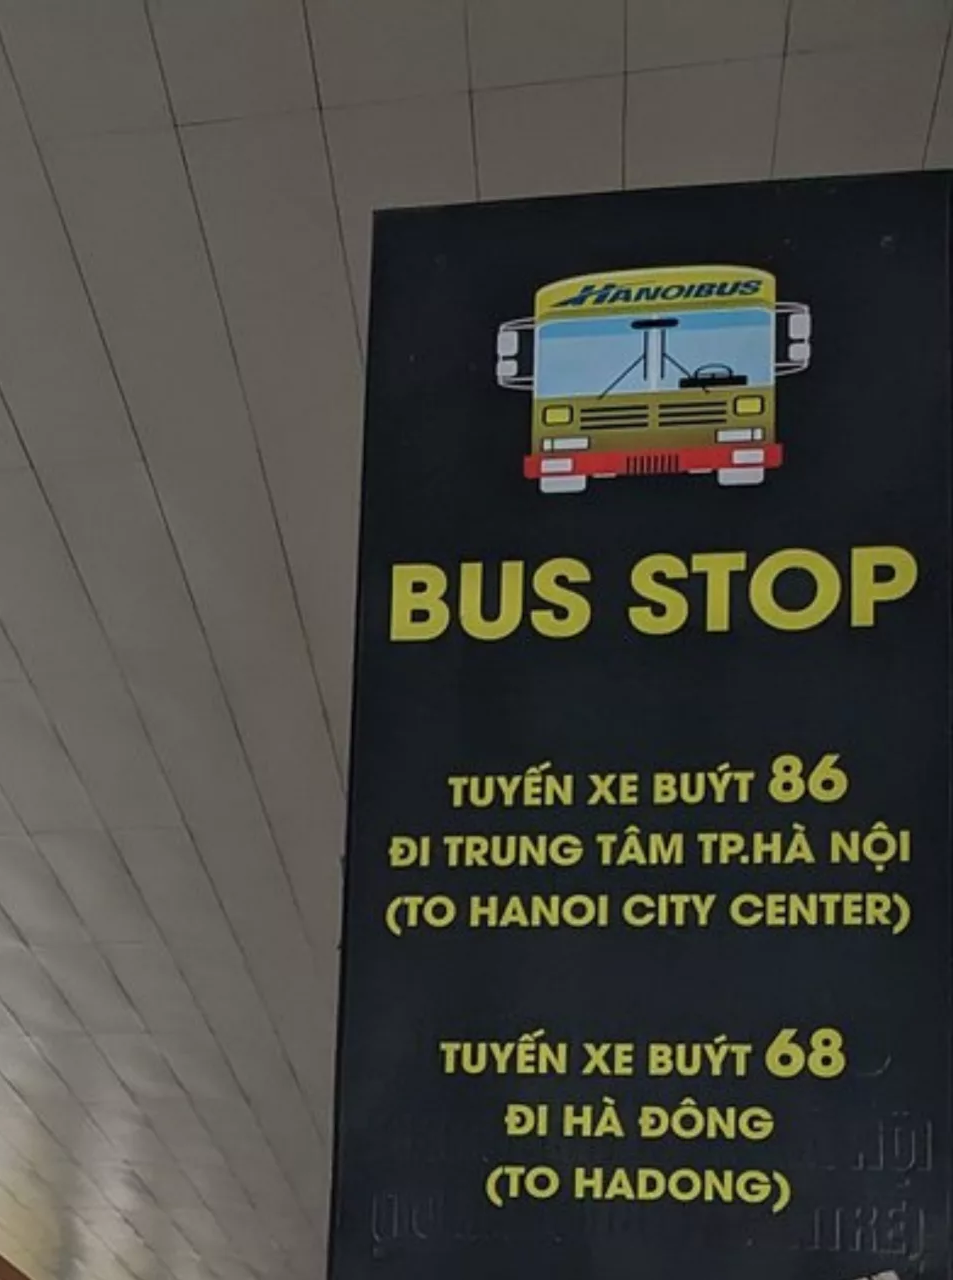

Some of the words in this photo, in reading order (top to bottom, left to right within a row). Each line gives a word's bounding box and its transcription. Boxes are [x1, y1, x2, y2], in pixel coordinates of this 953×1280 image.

[551, 279, 763, 308] HANOIBUS
[389, 556, 593, 642] BUS
[627, 545, 919, 636] STOP
[448, 761, 575, 807] TUYẾN
[588, 772, 639, 806] XE
[652, 762, 754, 804] BUÝT
[767, 753, 849, 804] 86
[388, 835, 431, 868] ĐI
[444, 833, 584, 868] TRUNG
[595, 823, 684, 865] TÂM
[829, 820, 911, 872] NỘI
[384, 894, 456, 936] (TO
[469, 894, 610, 928] HANOI
[621, 892, 716, 927] CITY
[728, 891, 912, 935] CENTER)
[439, 1028, 568, 1075] TUYẾN
[582, 1041, 634, 1077] XE
[647, 1034, 752, 1078] BUÝT
[763, 1026, 847, 1079] 68
[503, 1103, 548, 1137] ĐI
[562, 1096, 625, 1138] HÀ
[638, 1096, 776, 1141] ĐÔNG
[484, 1164, 561, 1207] (TO
[573, 1166, 792, 1213] HADONG)
